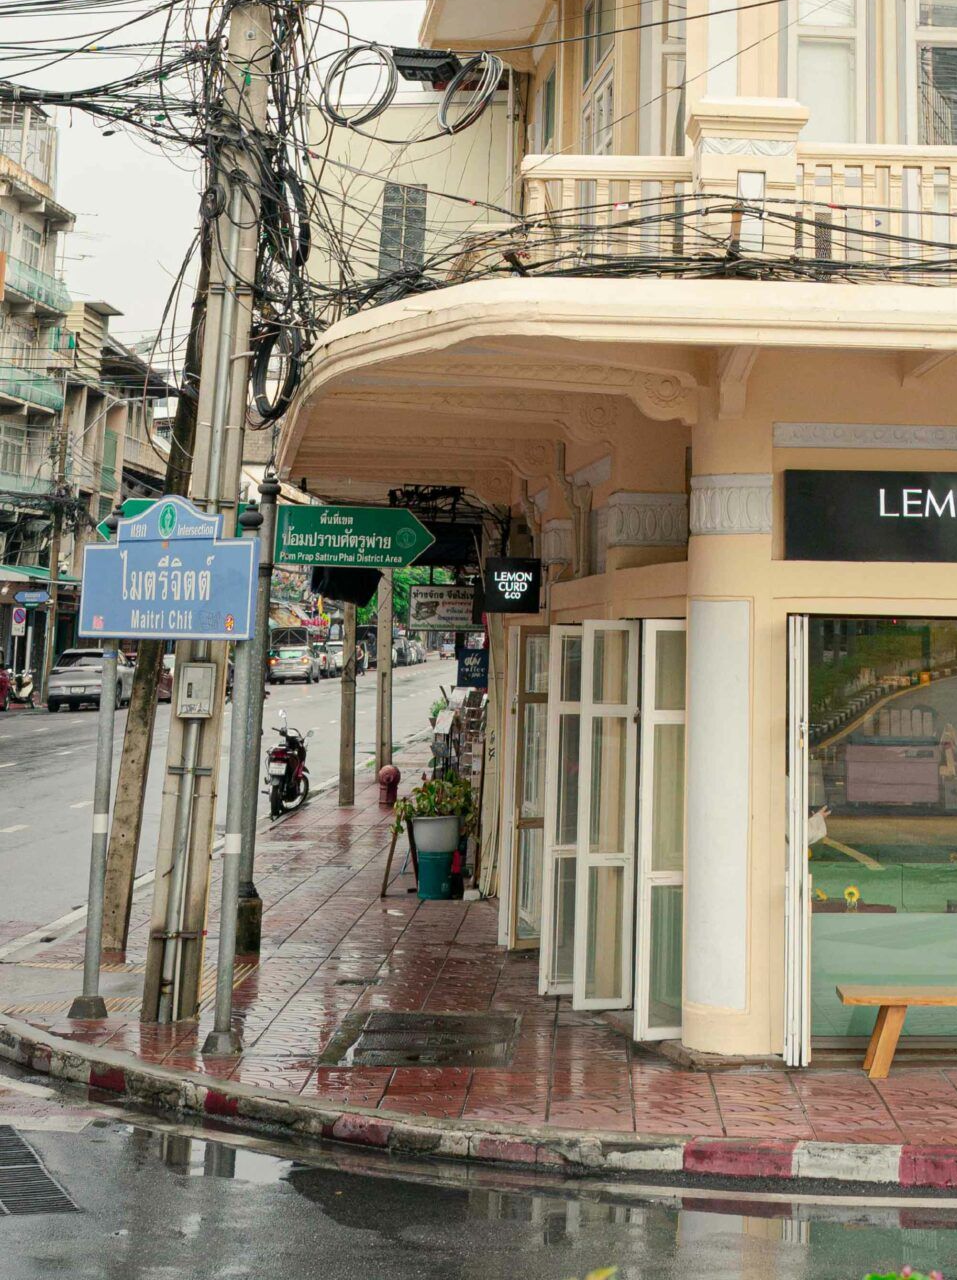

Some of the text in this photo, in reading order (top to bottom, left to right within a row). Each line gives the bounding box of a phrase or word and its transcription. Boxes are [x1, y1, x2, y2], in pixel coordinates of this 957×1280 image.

[177, 523, 214, 537] Intersection
[279, 552, 402, 563] Pom Prap Sattru Phai District Area
[119, 549, 215, 601] ไมตรีจิตต์
[494, 571, 533, 582] LEMON
[498, 582, 528, 592] CURD
[131, 610, 164, 629] Maitri
[168, 610, 192, 630] Chit
